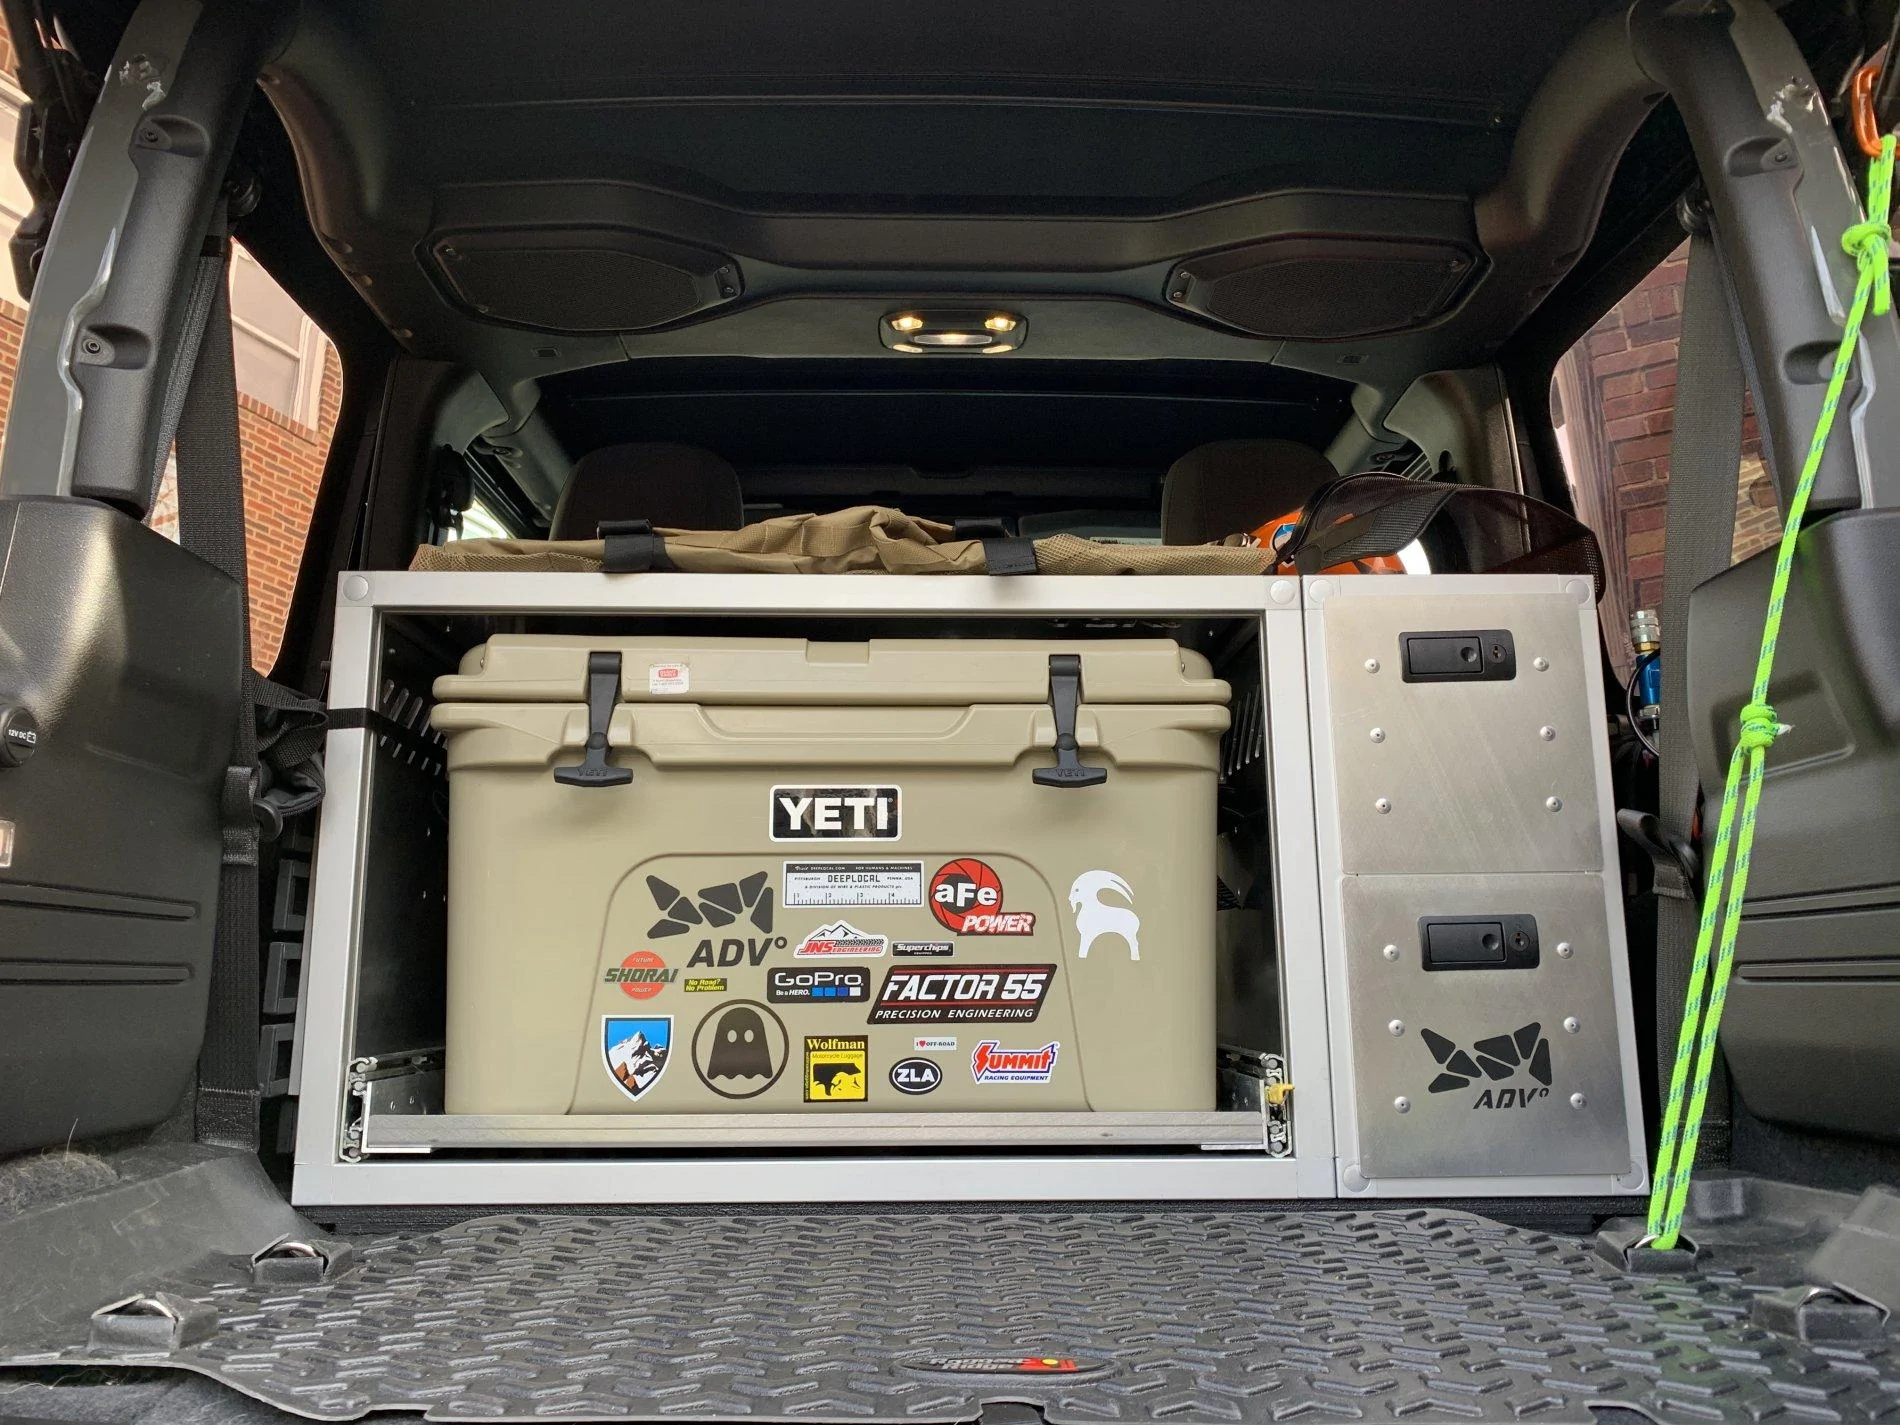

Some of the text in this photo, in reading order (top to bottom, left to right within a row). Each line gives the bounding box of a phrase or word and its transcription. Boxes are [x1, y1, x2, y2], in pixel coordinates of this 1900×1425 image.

[8, 729, 27, 739] 12V DC
[778, 797, 888, 830] YETI
[827, 874, 881, 883] DEEPLOCAL
[934, 882, 998, 907] aFe
[961, 914, 1033, 933] POWER
[804, 940, 836, 953] JNS
[896, 943, 949, 952] Superchips
[604, 968, 679, 983] SHORAI
[775, 971, 862, 986] GoPro
[697, 984, 725, 992] Problem
[881, 973, 1048, 1000] FACTOR 55
[875, 1008, 1034, 1019] PRECISION ENGINEERING
[806, 1038, 866, 1050] Wolfman
[897, 1068, 935, 1083] ZLA
